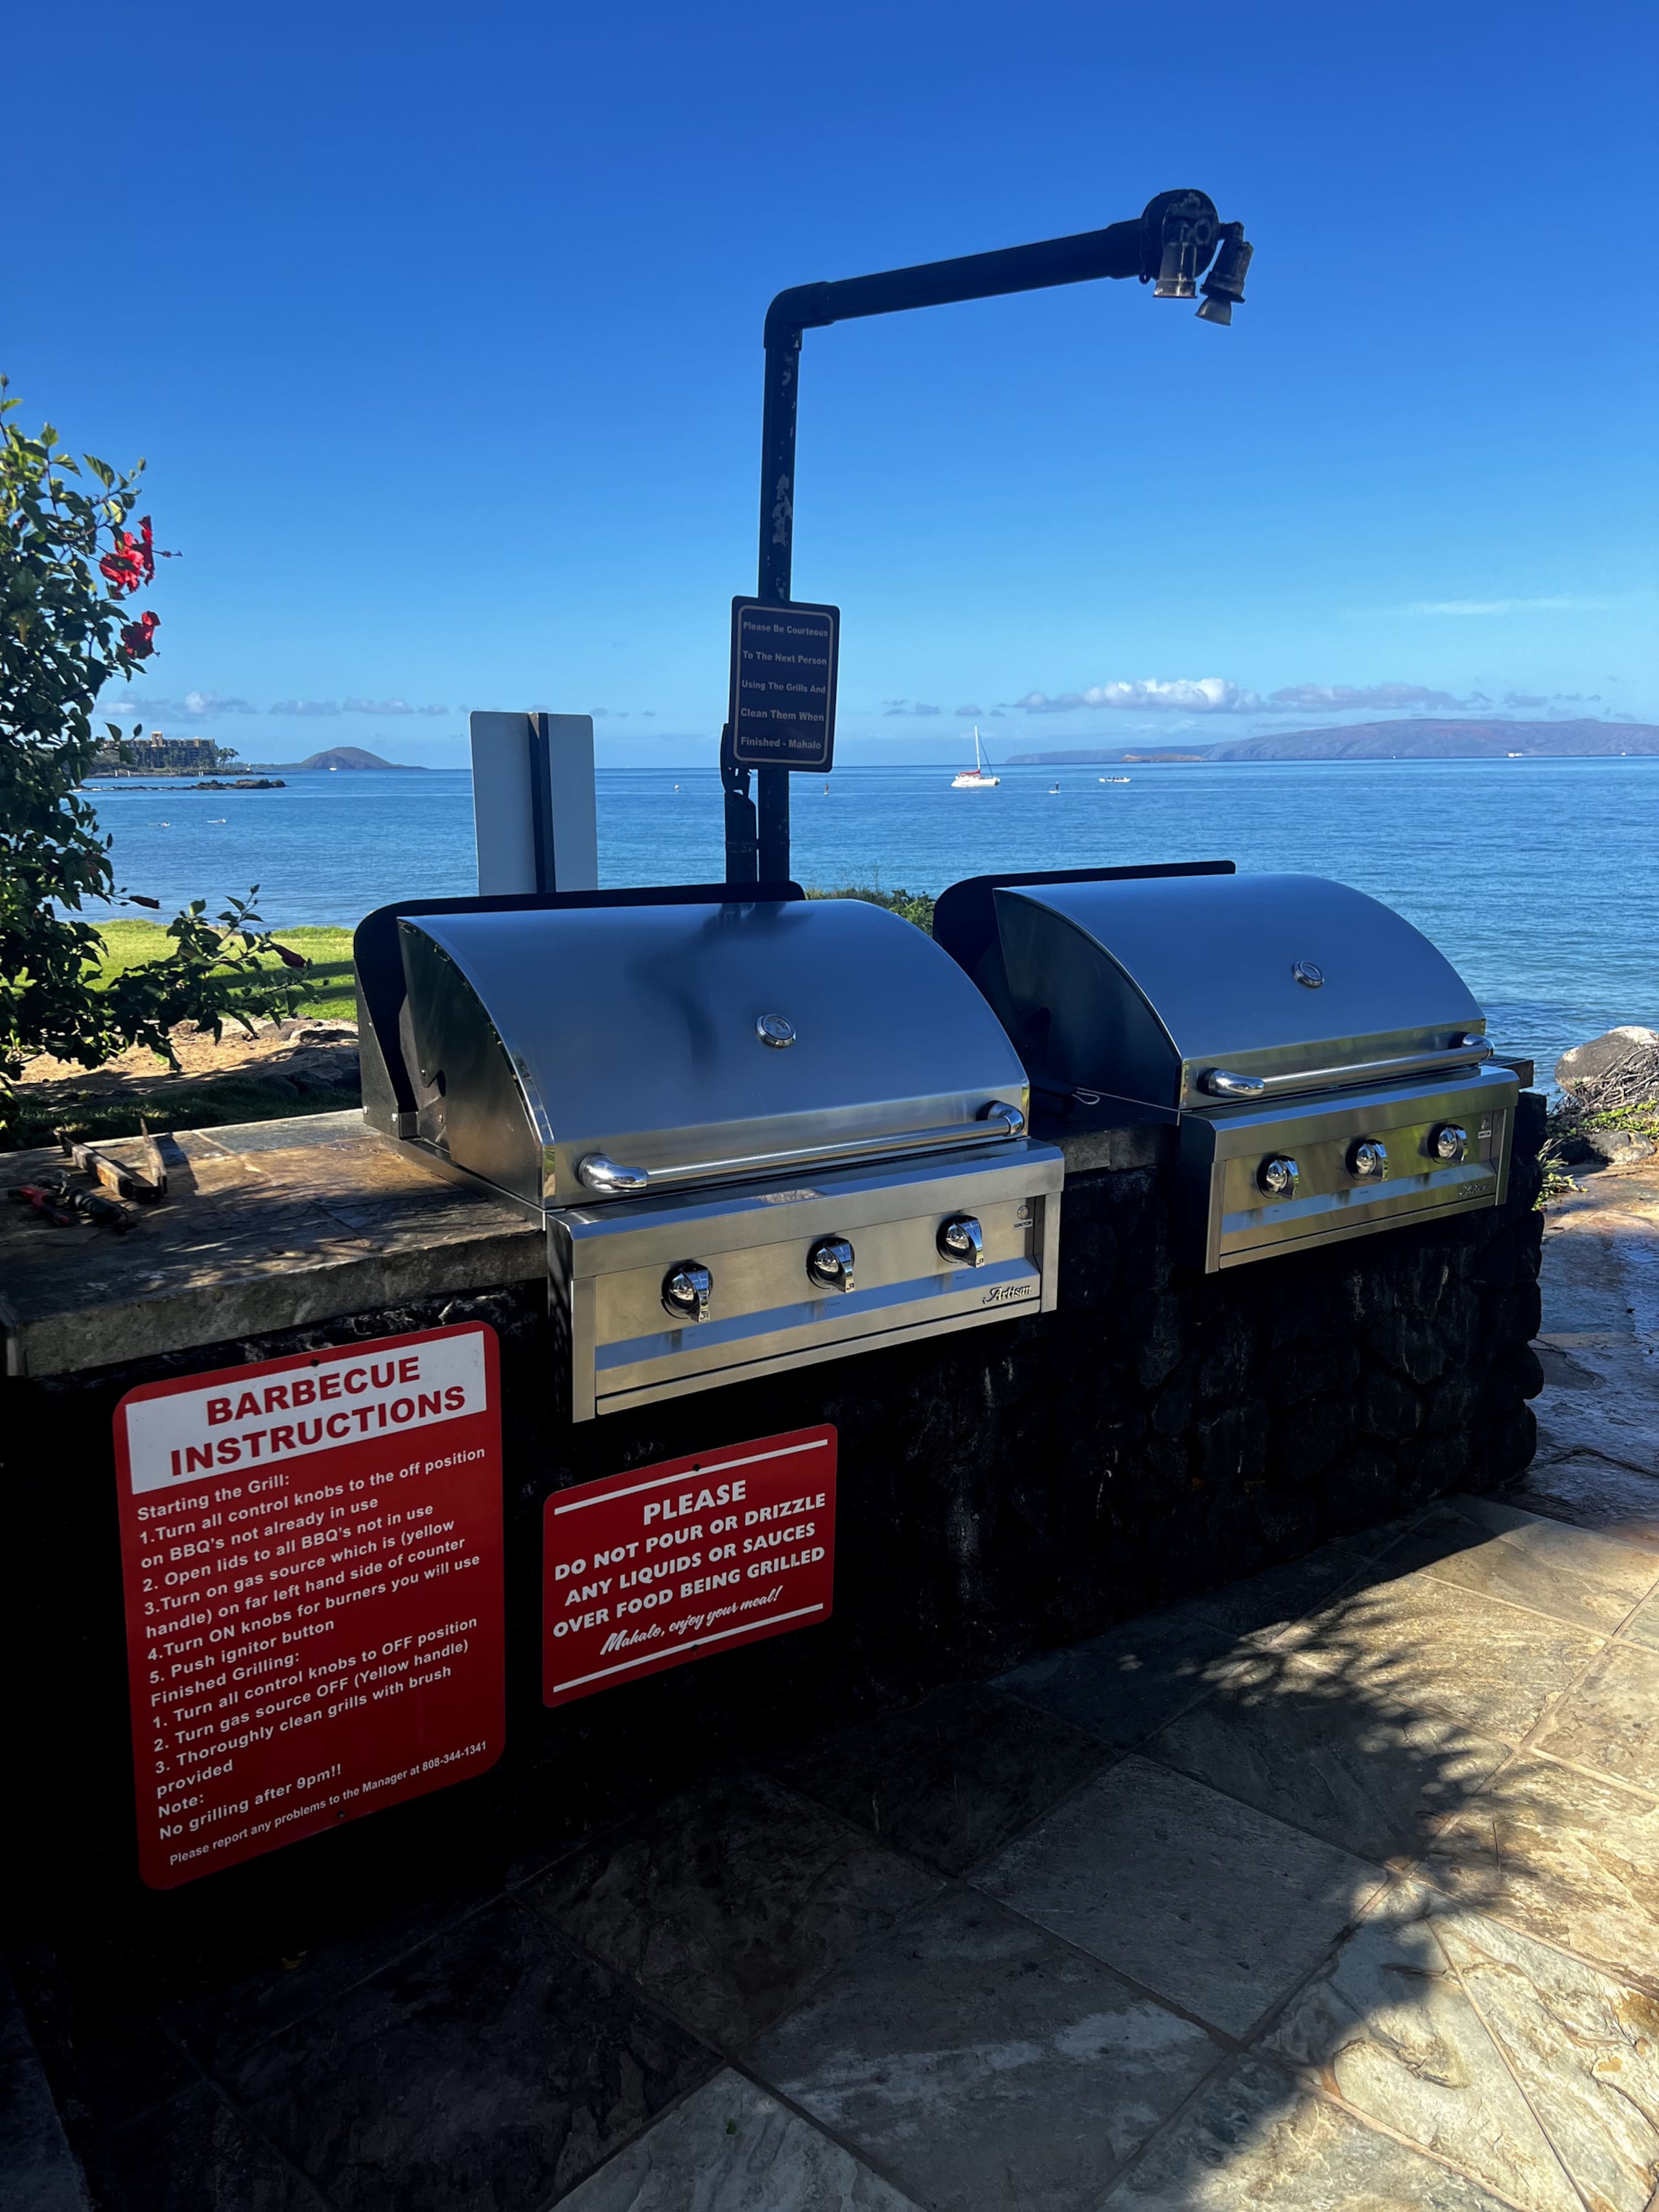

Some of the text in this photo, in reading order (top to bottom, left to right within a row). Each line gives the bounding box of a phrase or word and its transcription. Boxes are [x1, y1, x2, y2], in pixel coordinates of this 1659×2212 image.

[742, 649, 827, 666] To The Next Person
[743, 621, 828, 637] Please Be Courteous
[740, 707, 824, 722] Clean Them When
[741, 679, 826, 693] Using The Grills And
[741, 736, 781, 747] Finished
[788, 739, 822, 750] Mahalo
[206, 1356, 421, 1426] BARBECUE
[170, 1386, 465, 1476] INSTRUCTIONS
[137, 1474, 289, 1521] Starting the Grill:
[202, 1512, 222, 1530] all
[228, 1496, 288, 1522] control
[294, 1485, 343, 1506] knobs
[349, 1480, 365, 1491] to
[369, 1472, 394, 1486] the
[399, 1461, 421, 1478] off
[424, 1449, 485, 1475] position
[644, 1479, 746, 1526] PLEASE
[141, 1498, 378, 1568] on BBQ's not already in use
[143, 1505, 434, 1592] 2. Open lids to all BBQ's not in use
[206, 1584, 227, 1598] on
[233, 1574, 264, 1593] gas
[270, 1557, 325, 1581] source
[331, 1541, 377, 1563] which
[382, 1537, 396, 1549] is
[400, 1520, 454, 1546] (yellow
[555, 1493, 826, 1581] DO NOT POUR OR DRIZZLE
[564, 1522, 815, 1607] ANY LIQUIDS OR SAUCES
[146, 1538, 465, 1638] handle) on far left hand side of counter
[209, 1624, 235, 1642] ON
[241, 1611, 292, 1634] knobs
[297, 1602, 320, 1617] for
[325, 1583, 386, 1609] burners
[391, 1573, 419, 1592] you
[423, 1561, 449, 1579] will
[454, 1555, 480, 1570] use
[553, 1546, 825, 1637] OVER FOOD BEING GRILLED
[599, 1585, 783, 1655] Mahalo, enjoy your meal!
[150, 1620, 334, 1684] 5. Push ignitor button
[151, 1653, 299, 1707] Finished Grilling:
[153, 1618, 477, 1729] 1. Turn all control knobs to OFF position
[154, 1638, 468, 1752] 2. Turn gas source OFF (Yellow handle)
[156, 1666, 451, 1774] 3. Thoroughly clean grills with brush
[157, 1759, 233, 1799] provided
[158, 1794, 203, 1819] Note:
[159, 1763, 341, 1840] No grilling after 9pm!!
[170, 1740, 486, 1866] Please report any problems to the Manager at 808-344-1341
